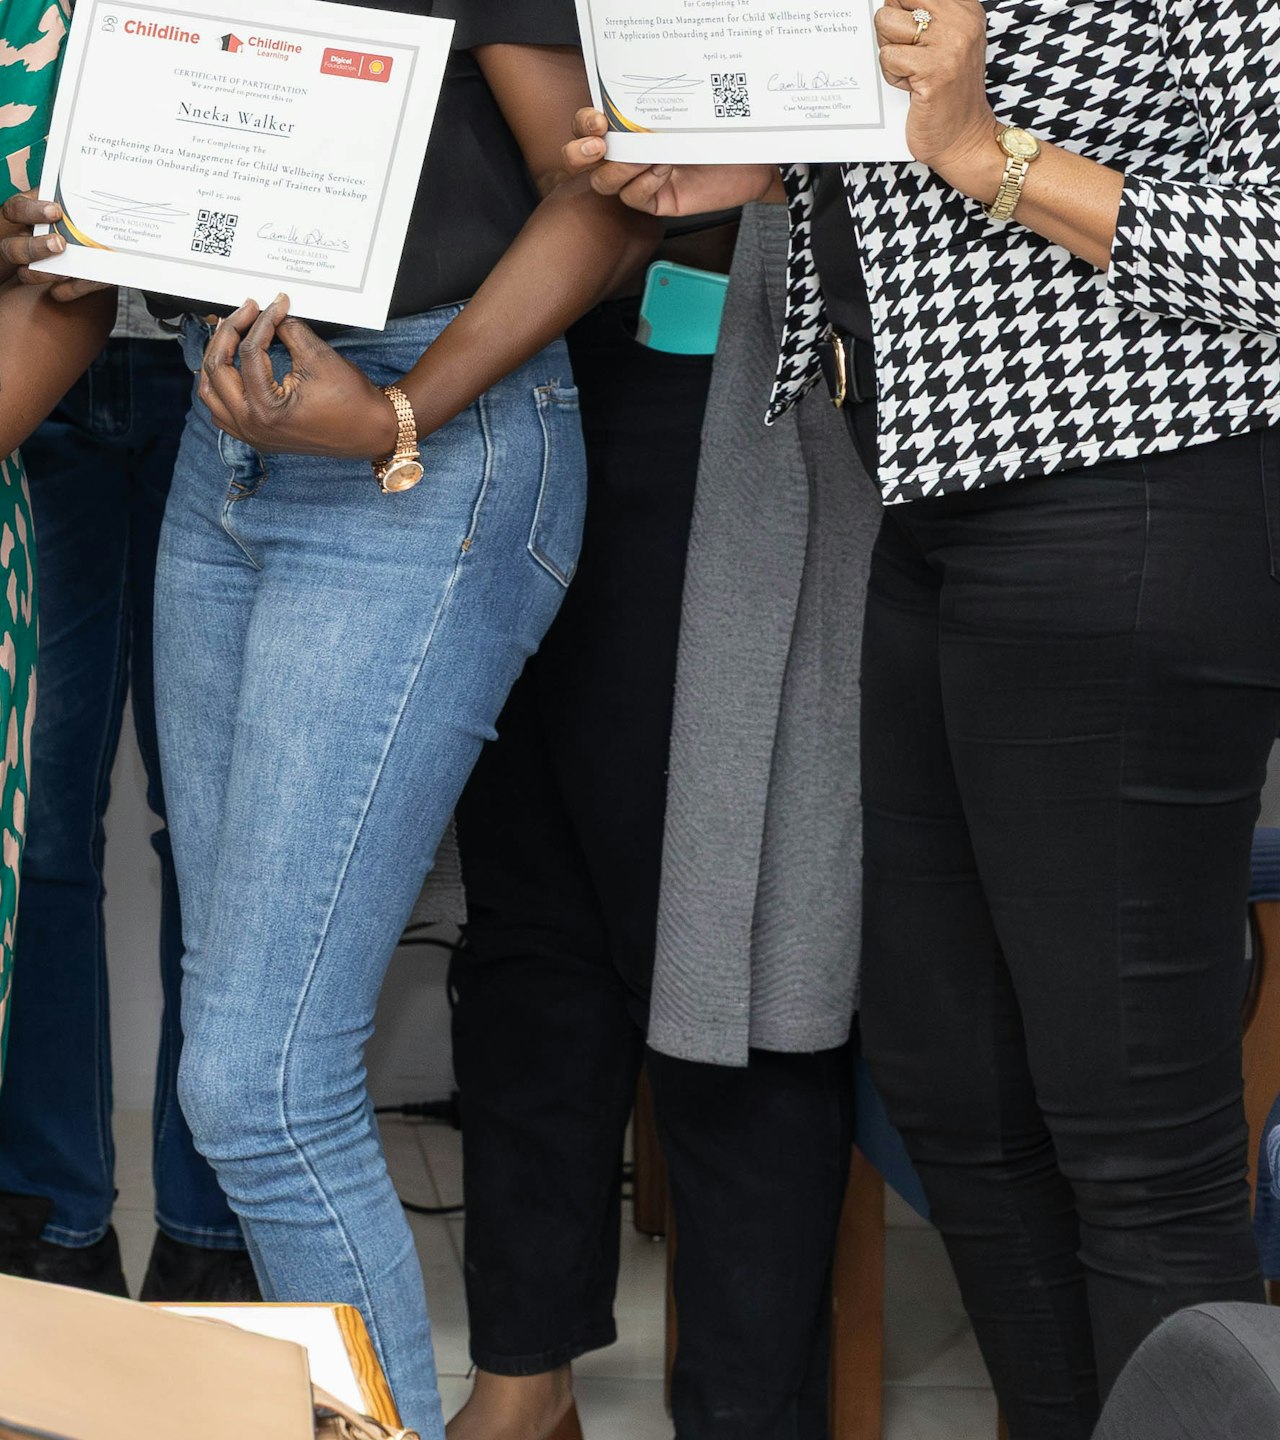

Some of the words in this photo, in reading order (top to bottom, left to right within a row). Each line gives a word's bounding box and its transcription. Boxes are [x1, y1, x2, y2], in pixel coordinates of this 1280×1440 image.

[124, 20, 200, 45] Childline
[248, 36, 302, 54] Childline
[256, 49, 289, 62] Learning
[329, 55, 352, 64] Digicel
[173, 68, 227, 83] CERTIFICATE
[229, 77, 241, 85] OF
[242, 79, 308, 95] PARTICIPATION
[178, 101, 229, 123] Nneka
[238, 111, 295, 133] Walker
